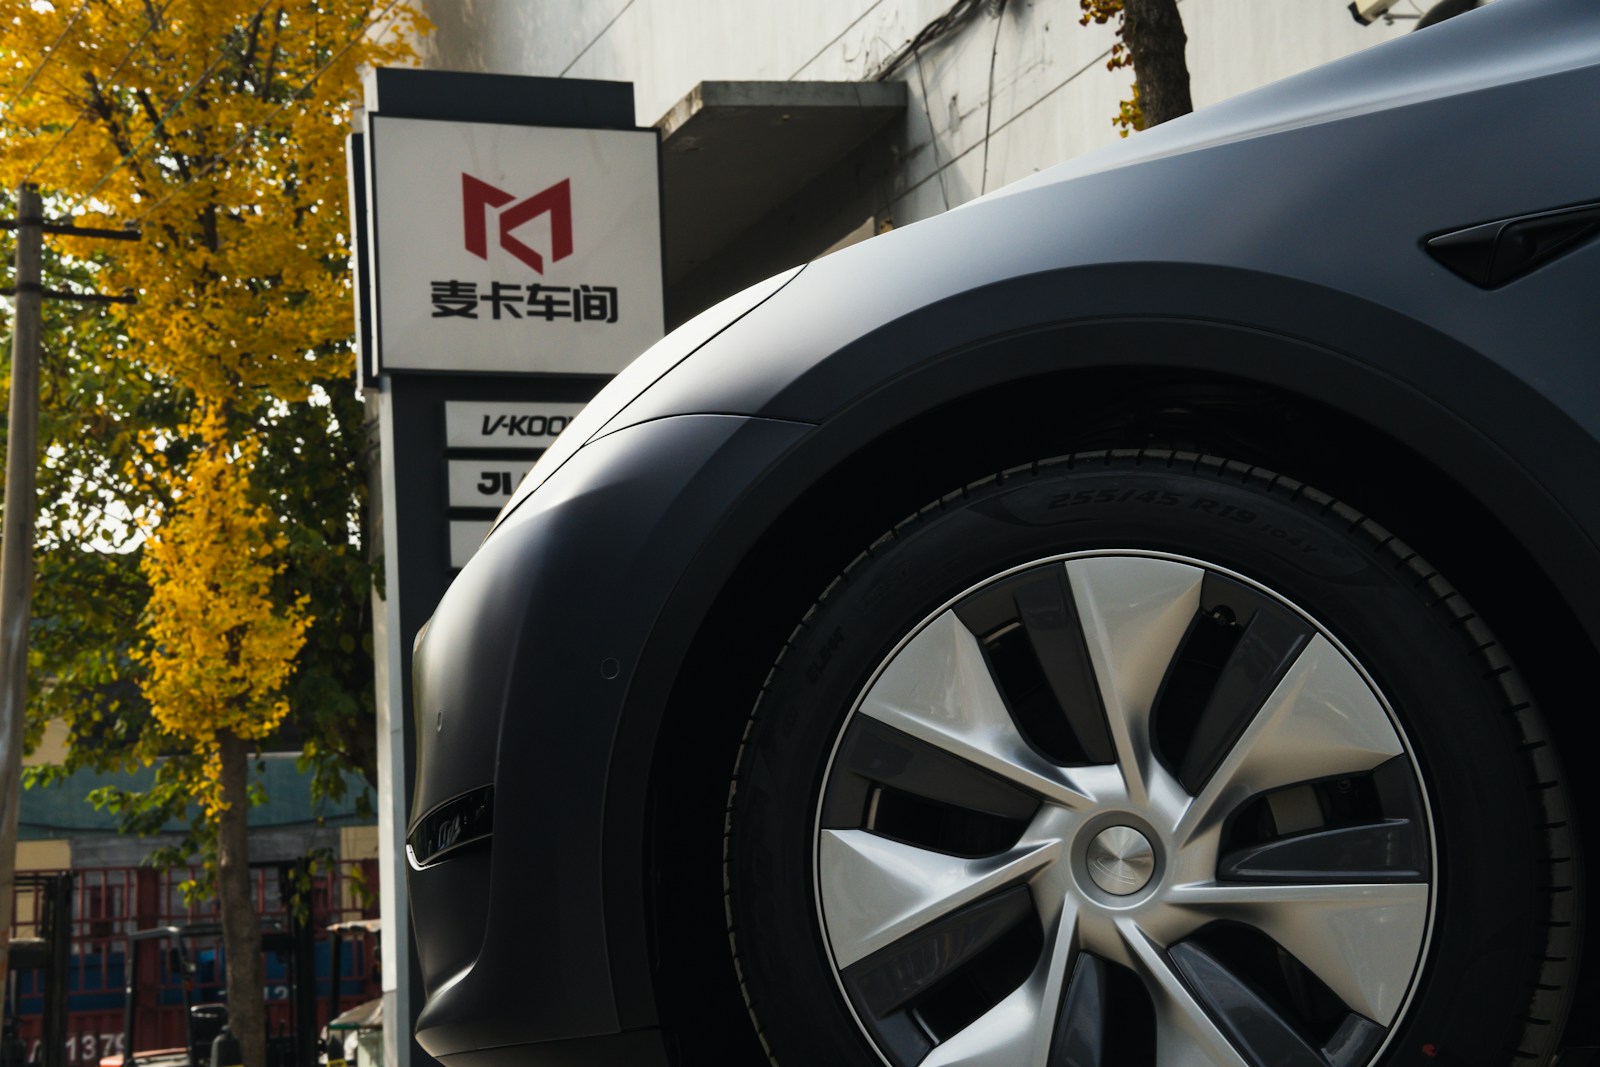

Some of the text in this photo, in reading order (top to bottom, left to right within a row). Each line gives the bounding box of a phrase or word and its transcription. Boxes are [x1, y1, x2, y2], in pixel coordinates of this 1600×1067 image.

[430, 280, 619, 324] 麦卡车间
[477, 471, 526, 495] JI
[1048, 488, 1185, 511] 255/45
[1187, 497, 1259, 524] R19
